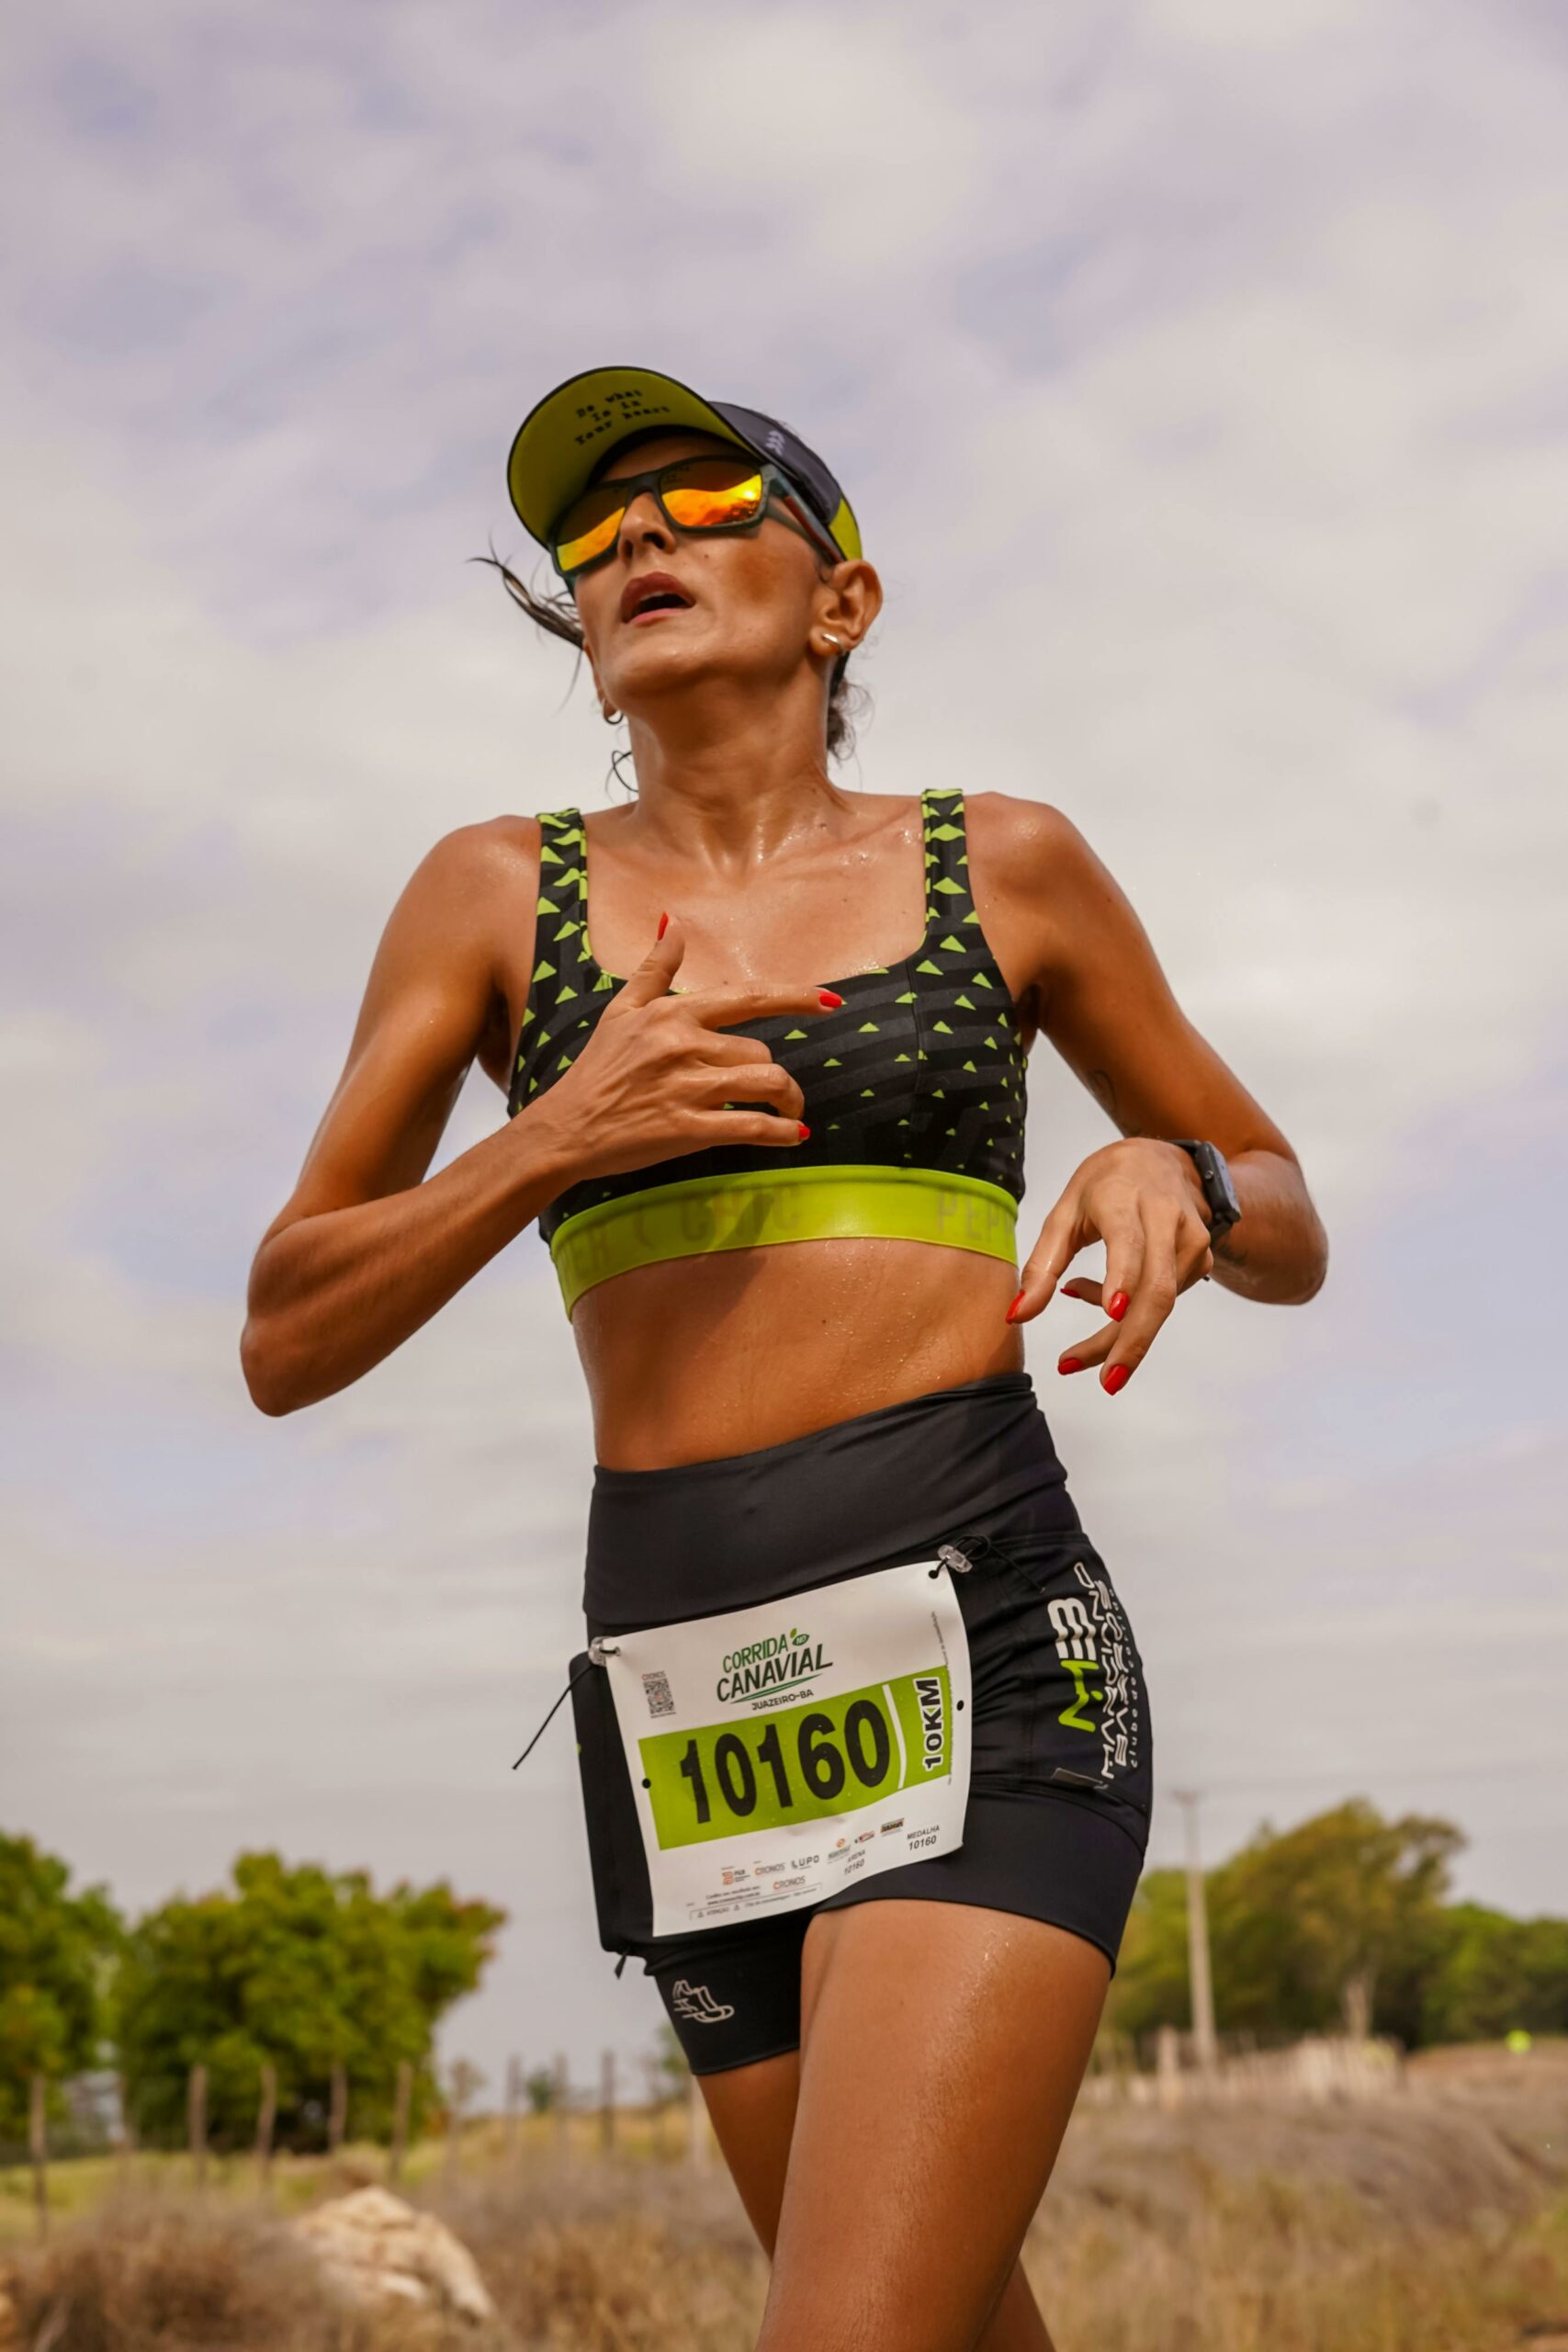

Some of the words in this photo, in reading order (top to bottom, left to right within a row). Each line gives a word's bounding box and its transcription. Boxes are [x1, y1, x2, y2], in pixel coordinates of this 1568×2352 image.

[722, 1633, 789, 1674] CORRIDA
[716, 1643, 834, 1702] CANAVIAL
[914, 1678, 943, 1770] 10KM
[679, 1699, 891, 1825] 10160
[907, 1825, 940, 1840] MEDALHA
[908, 1835, 937, 1851] 10160
[791, 1854, 820, 1870] LUPO
[847, 1849, 865, 1863] ARENA
[843, 1859, 865, 1875] 10160
[773, 1875, 807, 1891] CRONOS
